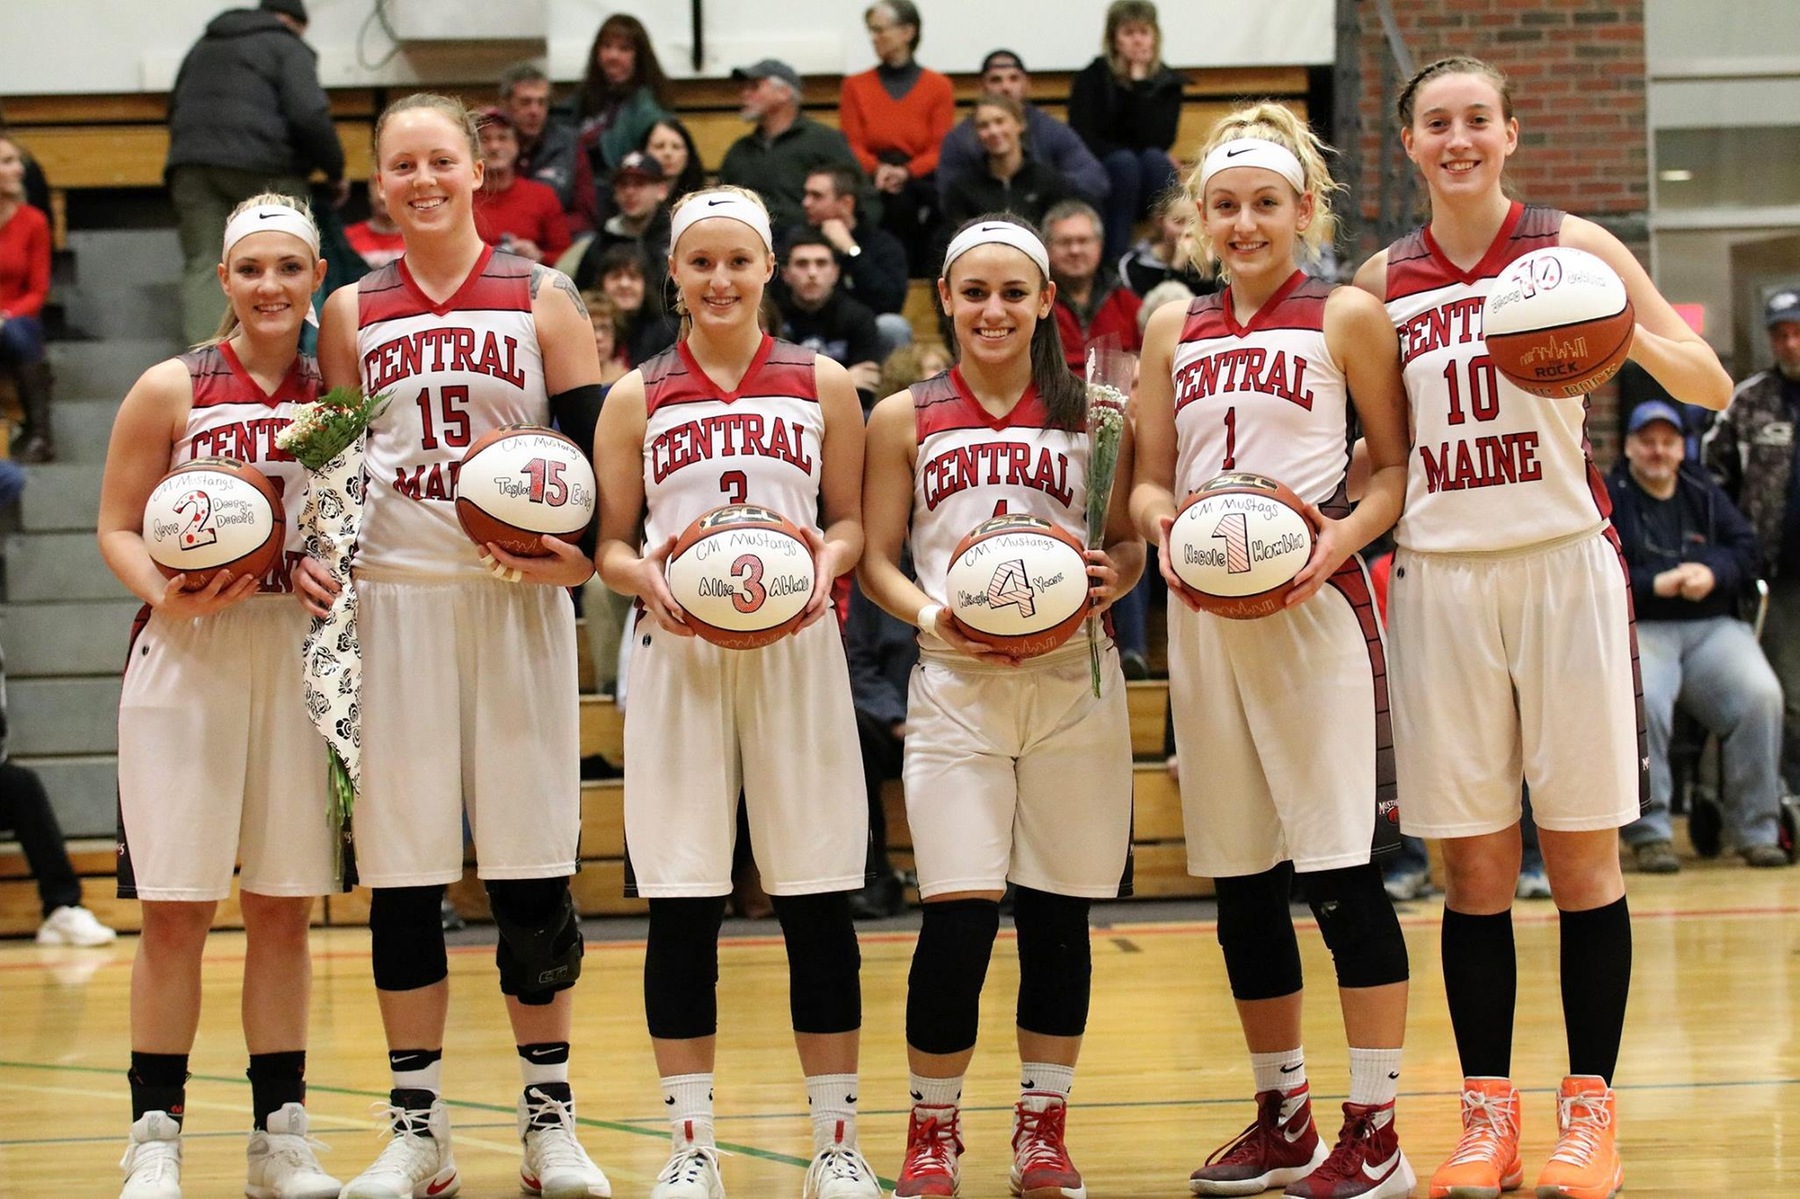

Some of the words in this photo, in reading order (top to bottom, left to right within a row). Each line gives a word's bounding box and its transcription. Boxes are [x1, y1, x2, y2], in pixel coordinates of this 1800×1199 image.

[365, 327, 526, 398] CENTRAL
[1396, 296, 1486, 373] CENT
[1443, 354, 1500, 425] 10
[1535, 361, 1579, 378] ROCK
[190, 418, 297, 463] CENT
[416, 385, 472, 450] 15
[1222, 406, 1236, 470] 1
[651, 413, 812, 485] CENTRAL
[923, 441, 1074, 512] CENTRAL
[1419, 431, 1542, 494] MAINE
[392, 461, 461, 502] MAI
[520, 457, 569, 508] 15
[1190, 502, 1214, 520] CM
[172, 490, 217, 552] 2
[696, 538, 722, 561] CM
[730, 532, 797, 557] Mustangs
[964, 543, 991, 568] CM
[995, 535, 1056, 552] Mustangs
[1184, 543, 1227, 568] Nicole
[1211, 512, 1252, 575] 1
[698, 576, 735, 598] Allie
[730, 553, 768, 614] 3
[986, 558, 1036, 619] 4
